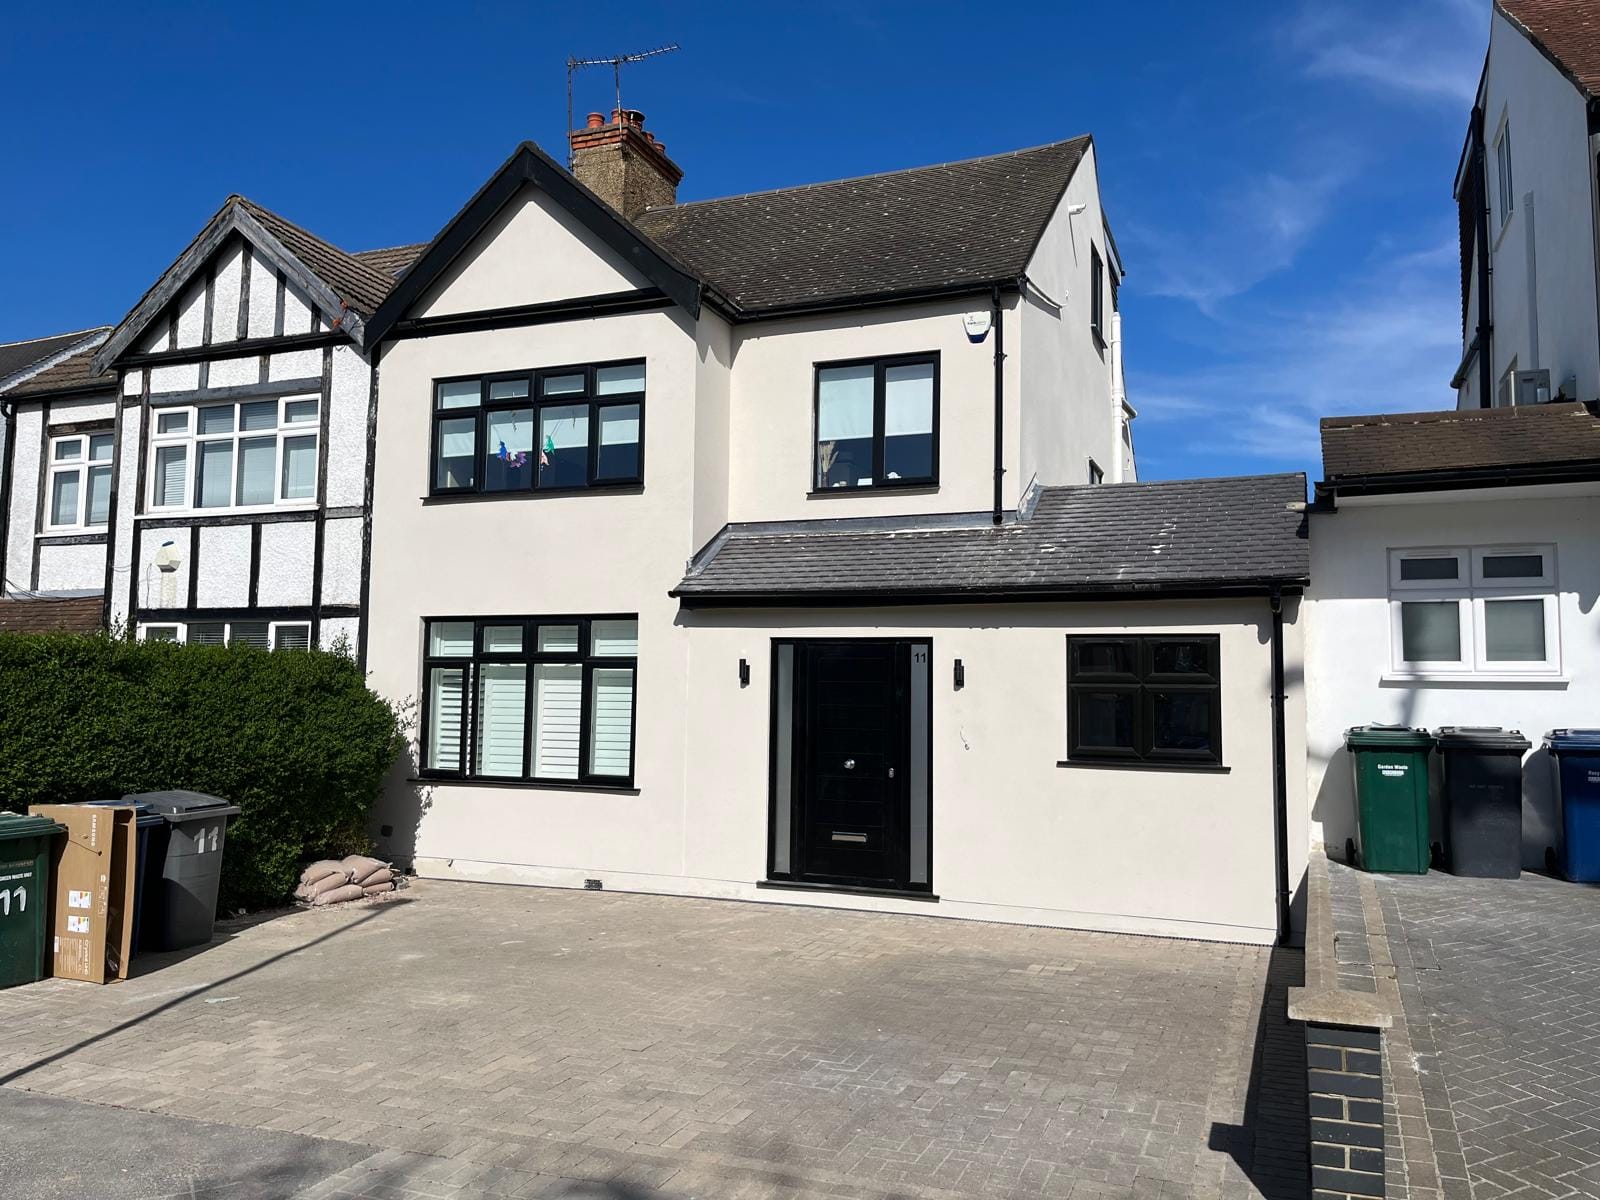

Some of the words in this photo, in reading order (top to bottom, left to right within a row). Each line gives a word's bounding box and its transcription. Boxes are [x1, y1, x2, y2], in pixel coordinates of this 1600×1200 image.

[914, 652, 926, 664] 11
[193, 826, 219, 854] 11
[0, 885, 27, 916] 11
